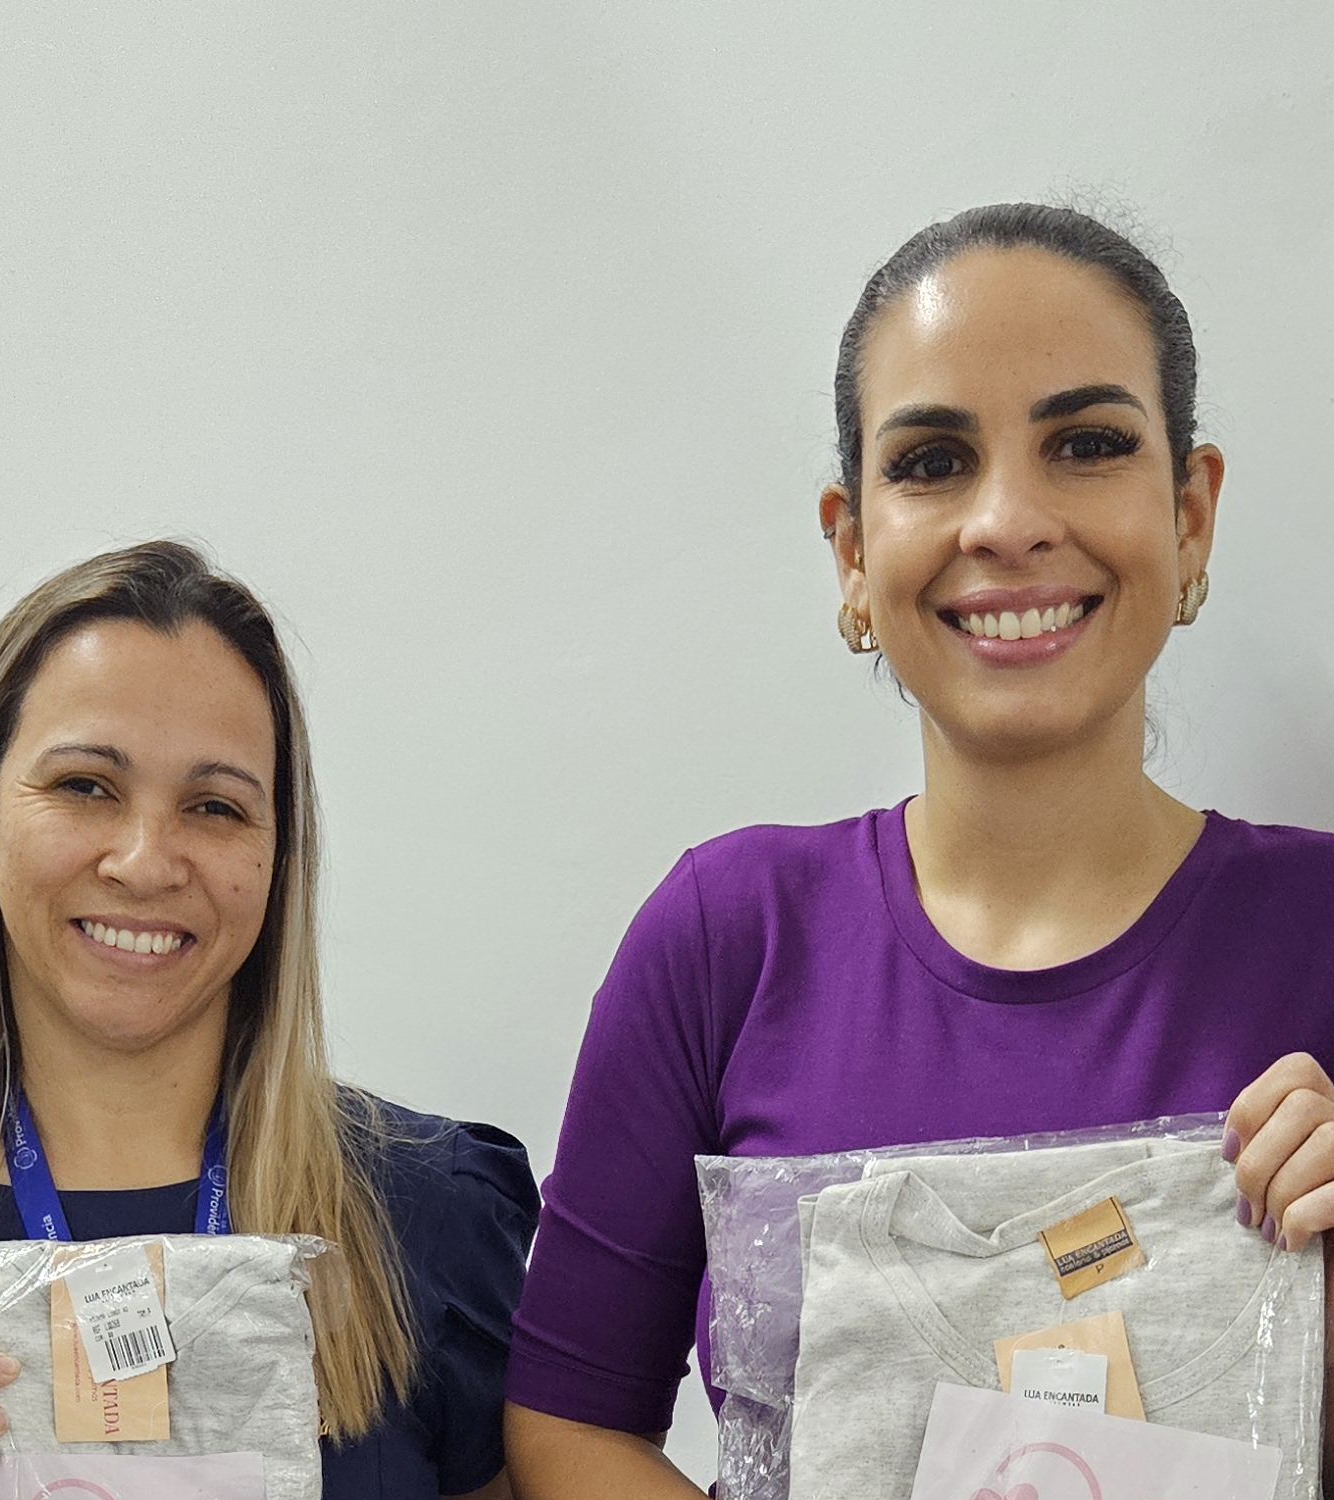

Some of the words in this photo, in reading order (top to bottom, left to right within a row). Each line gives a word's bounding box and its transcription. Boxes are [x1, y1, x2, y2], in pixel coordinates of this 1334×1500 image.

[1095, 1263, 1104, 1274] P
[84, 1292, 101, 1304] LUA
[101, 1277, 150, 1297] ENCANTADA
[1024, 1389, 1041, 1400] LUA
[1043, 1390, 1099, 1404] ENCANTADA
